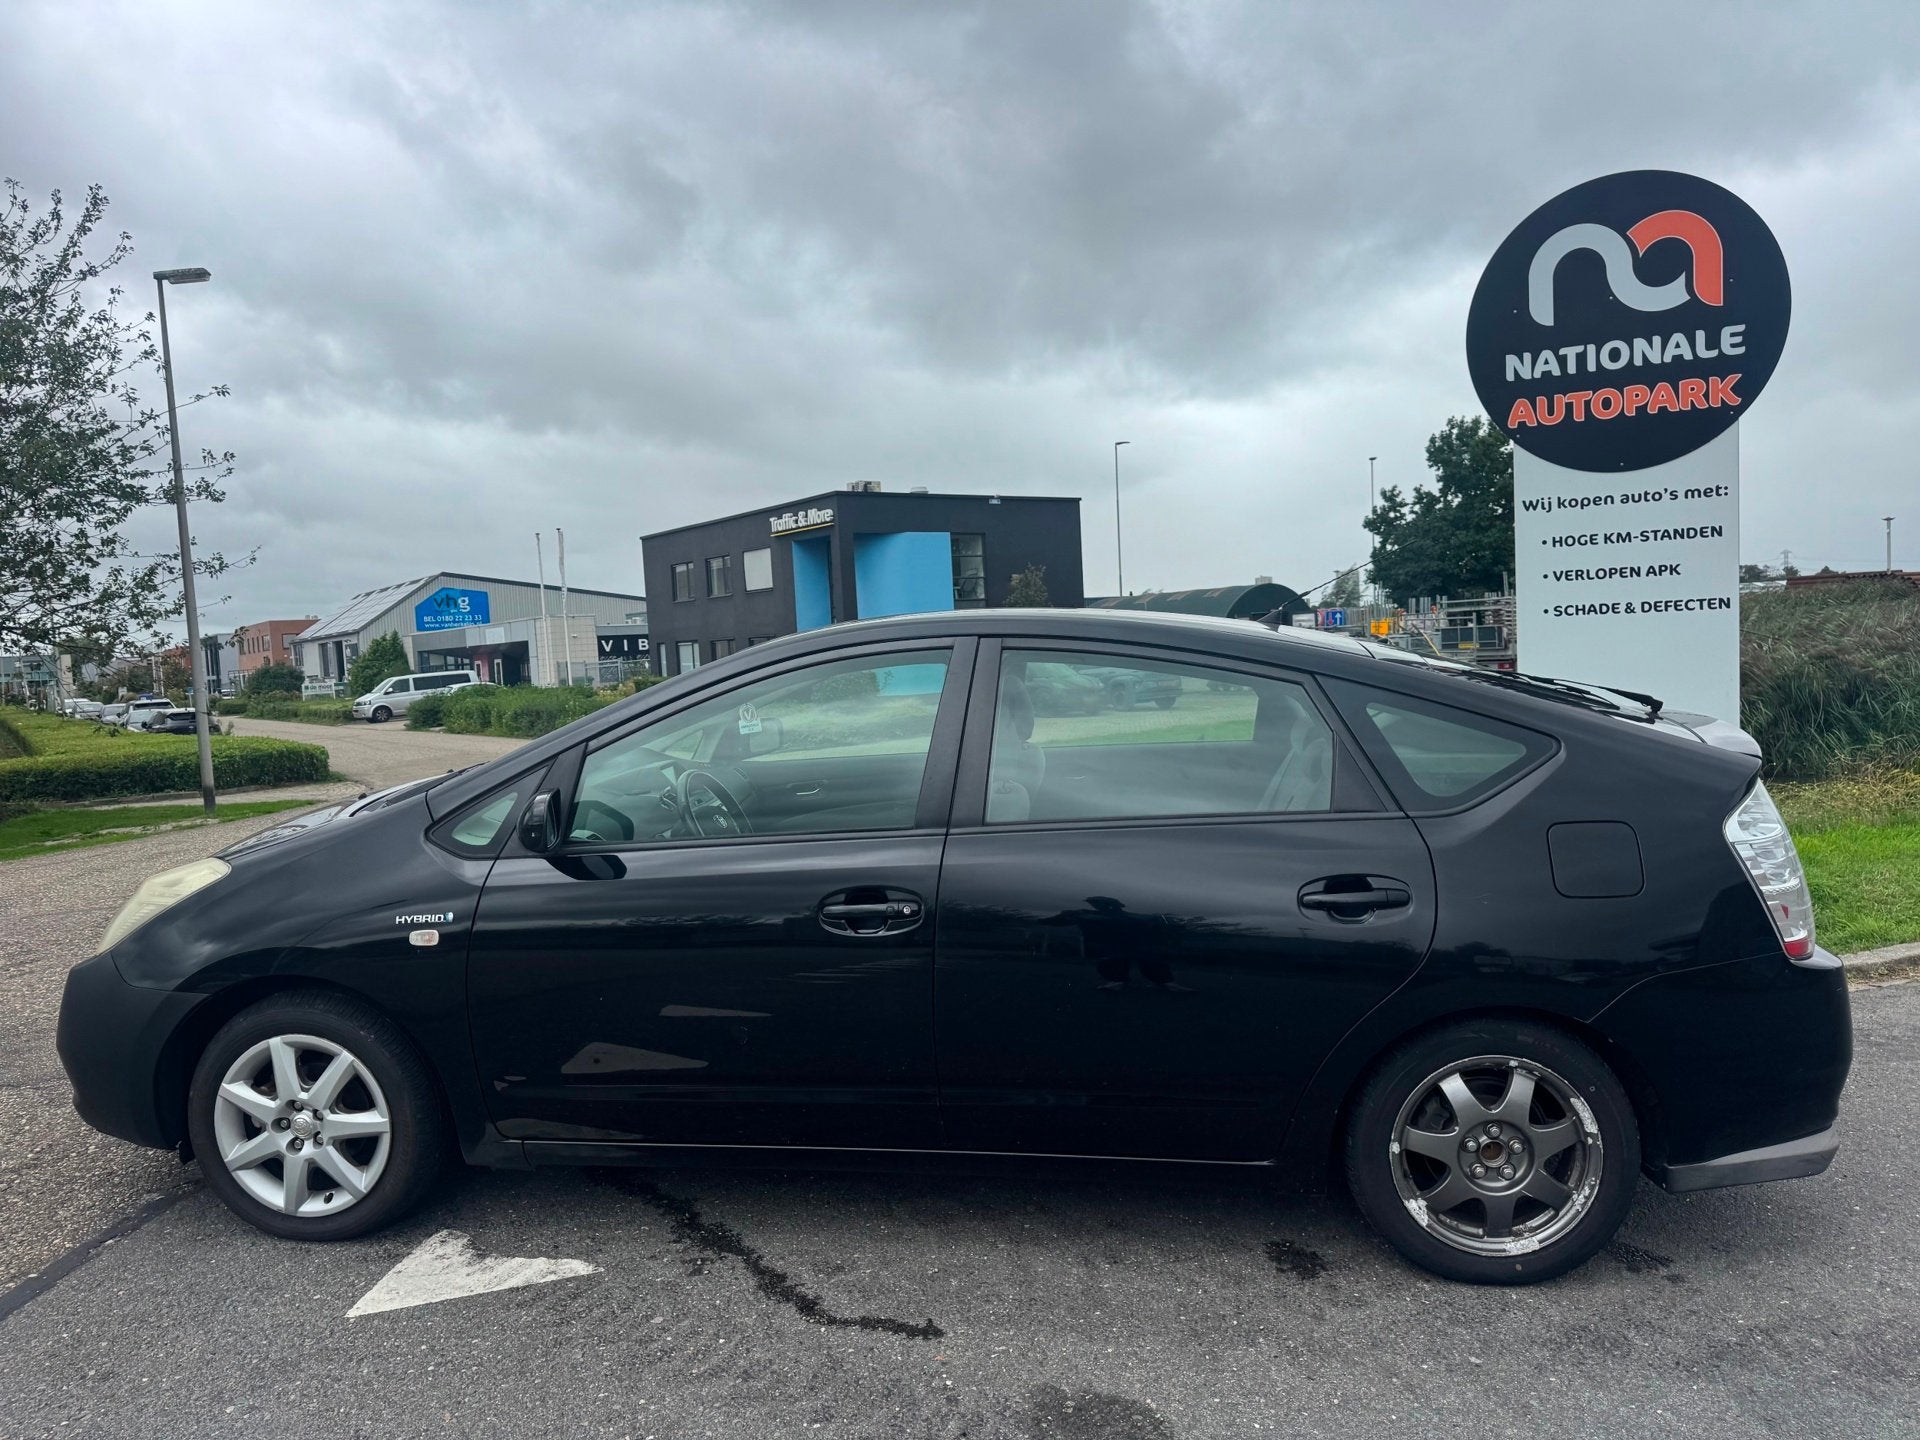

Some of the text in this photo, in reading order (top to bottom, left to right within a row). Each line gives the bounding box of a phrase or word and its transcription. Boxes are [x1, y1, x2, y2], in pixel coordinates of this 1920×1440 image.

[1505, 324, 1746, 382] NATIONALE
[1507, 373, 1743, 429] AUTOPARK
[1522, 484, 1729, 513] Wij kopen auto's met:
[798, 511, 808, 527] &
[807, 508, 834, 525] More
[1552, 525, 1723, 548] HOGE KM-STANDEN
[1553, 563, 1682, 582] VERLOPEN APK
[433, 593, 471, 612] vhg
[1553, 597, 1731, 617] SCHADE & DEFECTEN
[395, 914, 445, 924] HYBRID
